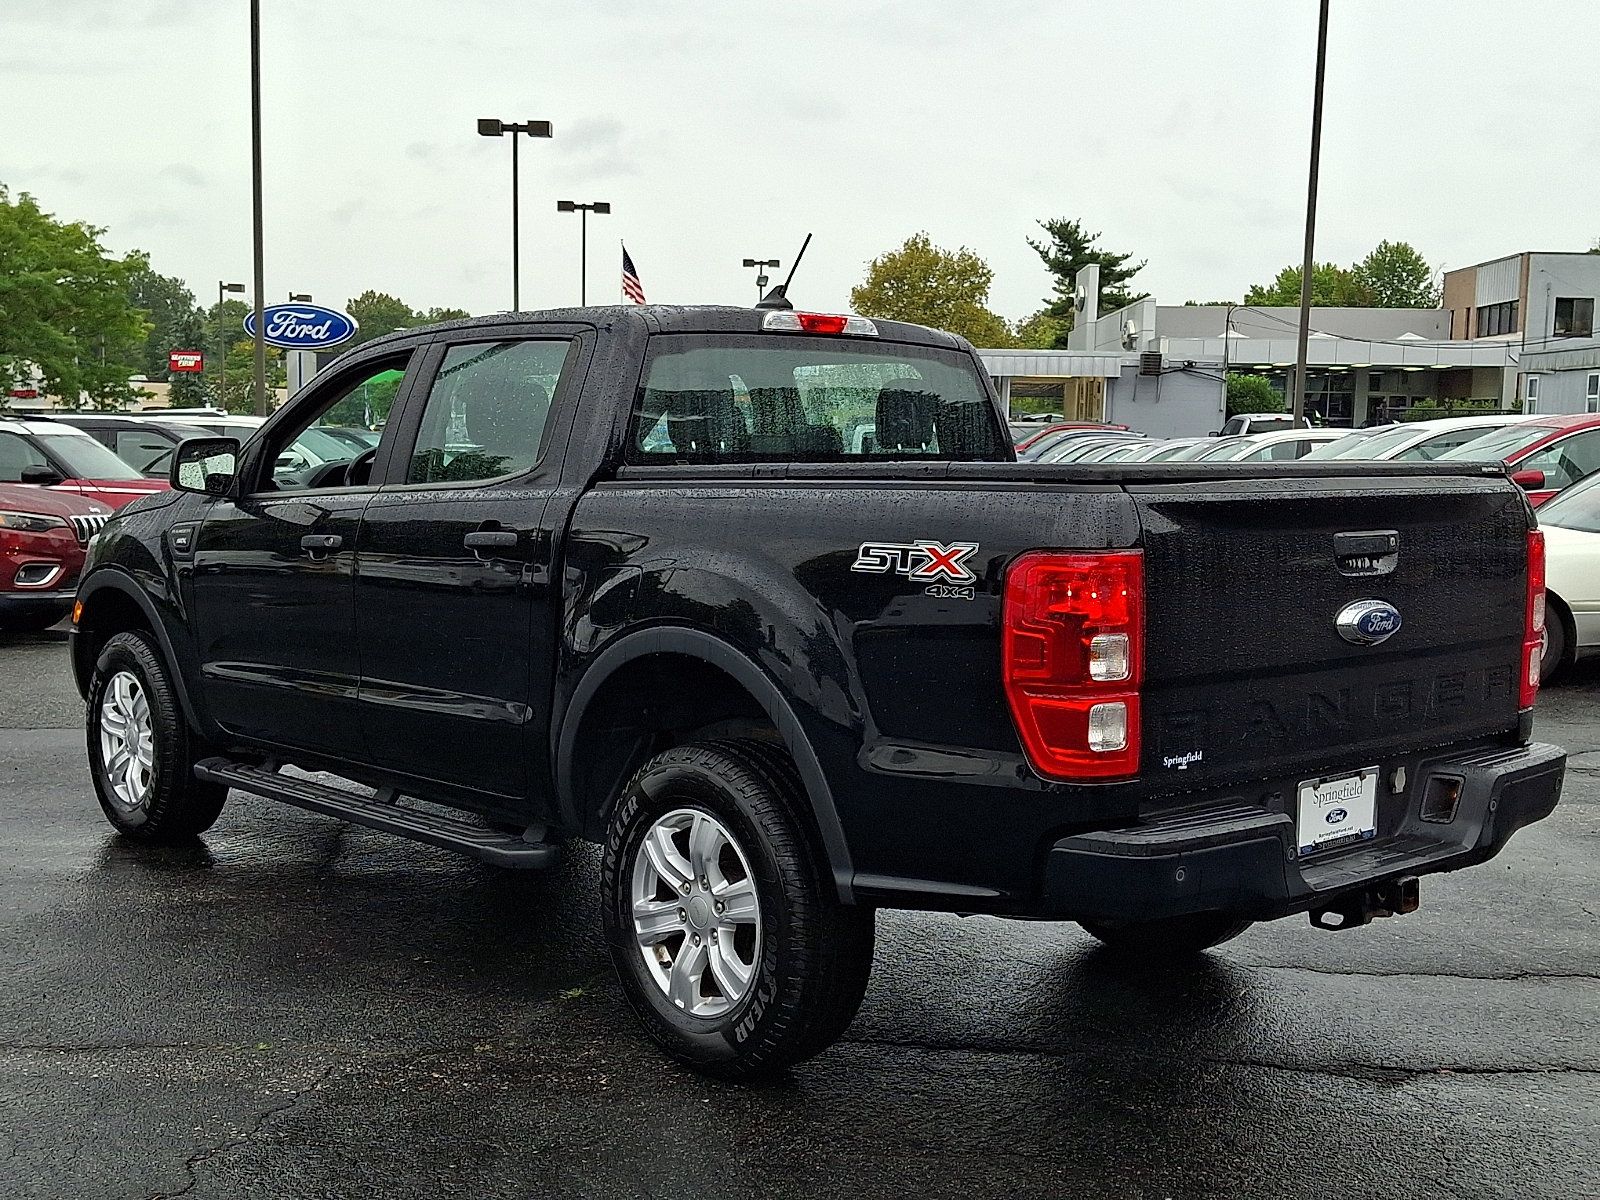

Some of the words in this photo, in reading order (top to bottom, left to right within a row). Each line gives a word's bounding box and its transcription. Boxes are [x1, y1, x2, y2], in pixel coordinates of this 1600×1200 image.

[267, 311, 332, 340] Ford
[851, 540, 979, 585] STX
[1368, 612, 1394, 633] Ford
[1163, 750, 1203, 768] Springfield
[1313, 781, 1363, 808] Springfield
[1328, 811, 1345, 823] Ford
